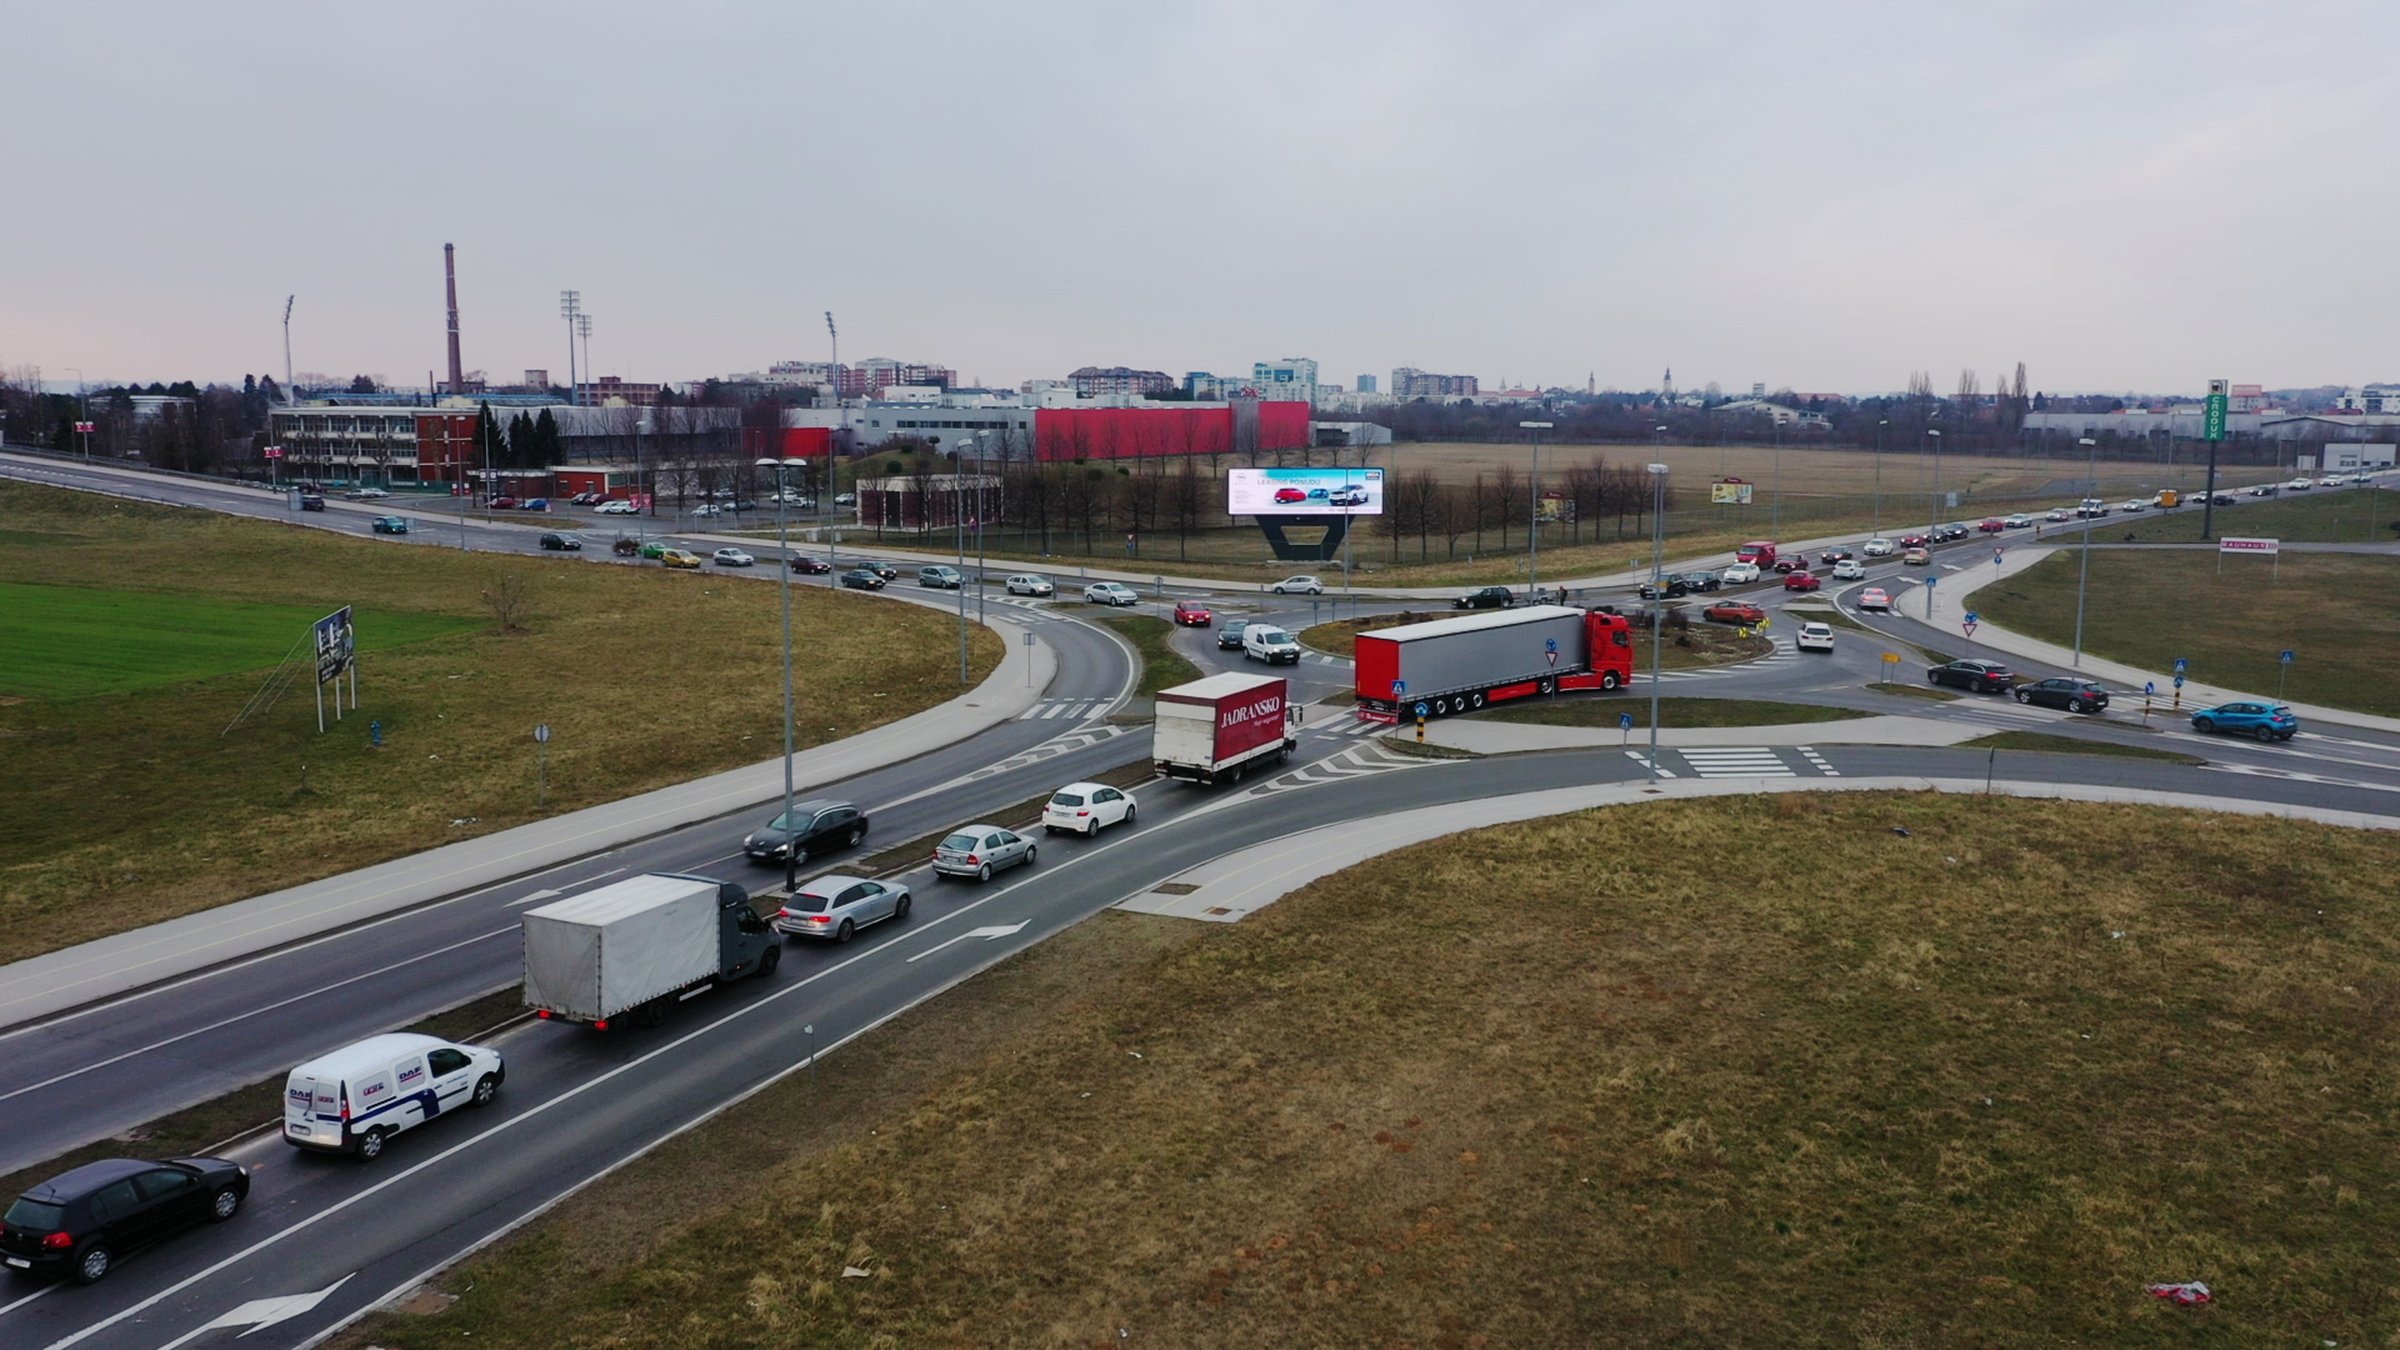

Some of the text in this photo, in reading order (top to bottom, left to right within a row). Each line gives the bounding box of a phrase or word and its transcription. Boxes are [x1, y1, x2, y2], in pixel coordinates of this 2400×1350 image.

[2209, 396, 2220, 439] CRODUX
[2221, 541, 2266, 549] BAUHAUS
[1221, 696, 1280, 729] JADRANSKO
[399, 1066, 422, 1079] DAF
